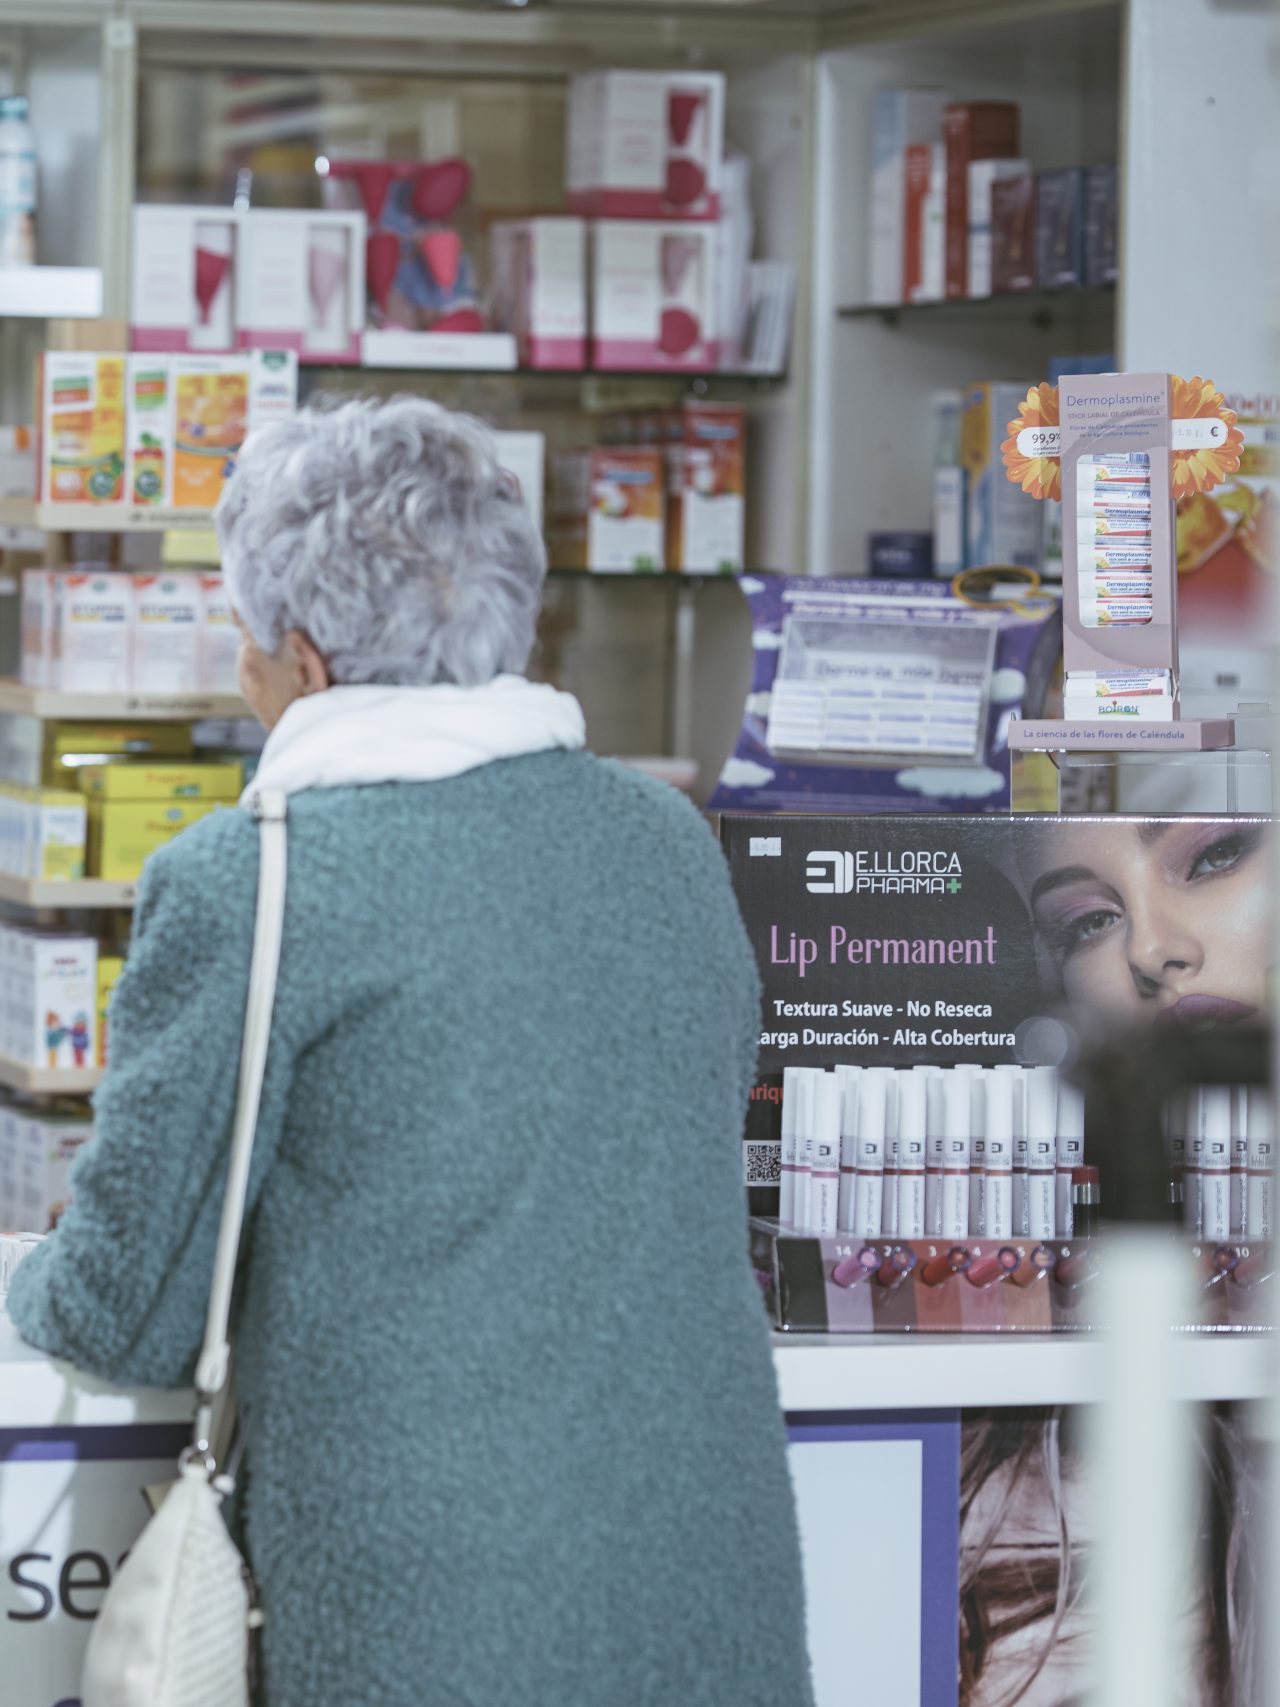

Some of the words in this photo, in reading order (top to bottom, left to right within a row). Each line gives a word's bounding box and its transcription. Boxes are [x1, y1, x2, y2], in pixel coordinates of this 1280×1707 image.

[1098, 700, 1140, 714] BOIRON
[1023, 729, 1034, 738] La
[1036, 729, 1068, 738] ciencia
[1070, 729, 1081, 738] de
[1083, 729, 1096, 739] las
[1098, 729, 1124, 739] flores
[1126, 729, 1137, 739] de
[1140, 728, 1185, 740] Caléndula
[856, 851, 962, 873] E.LLORCA
[771, 925, 818, 977] Lip
[830, 925, 998, 964] Permanent
[773, 1000, 838, 1017] Textura
[842, 1000, 893, 1017] Suave
[907, 1000, 931, 1017] No
[935, 1000, 993, 1017] Reseca
[757, 1030, 798, 1049] arga
[803, 1028, 879, 1046] Duración
[893, 1029, 927, 1046] Alta
[931, 1029, 1016, 1046] Cobertura
[835, 1245, 852, 1256] 14
[7, 1550, 128, 1622] se
